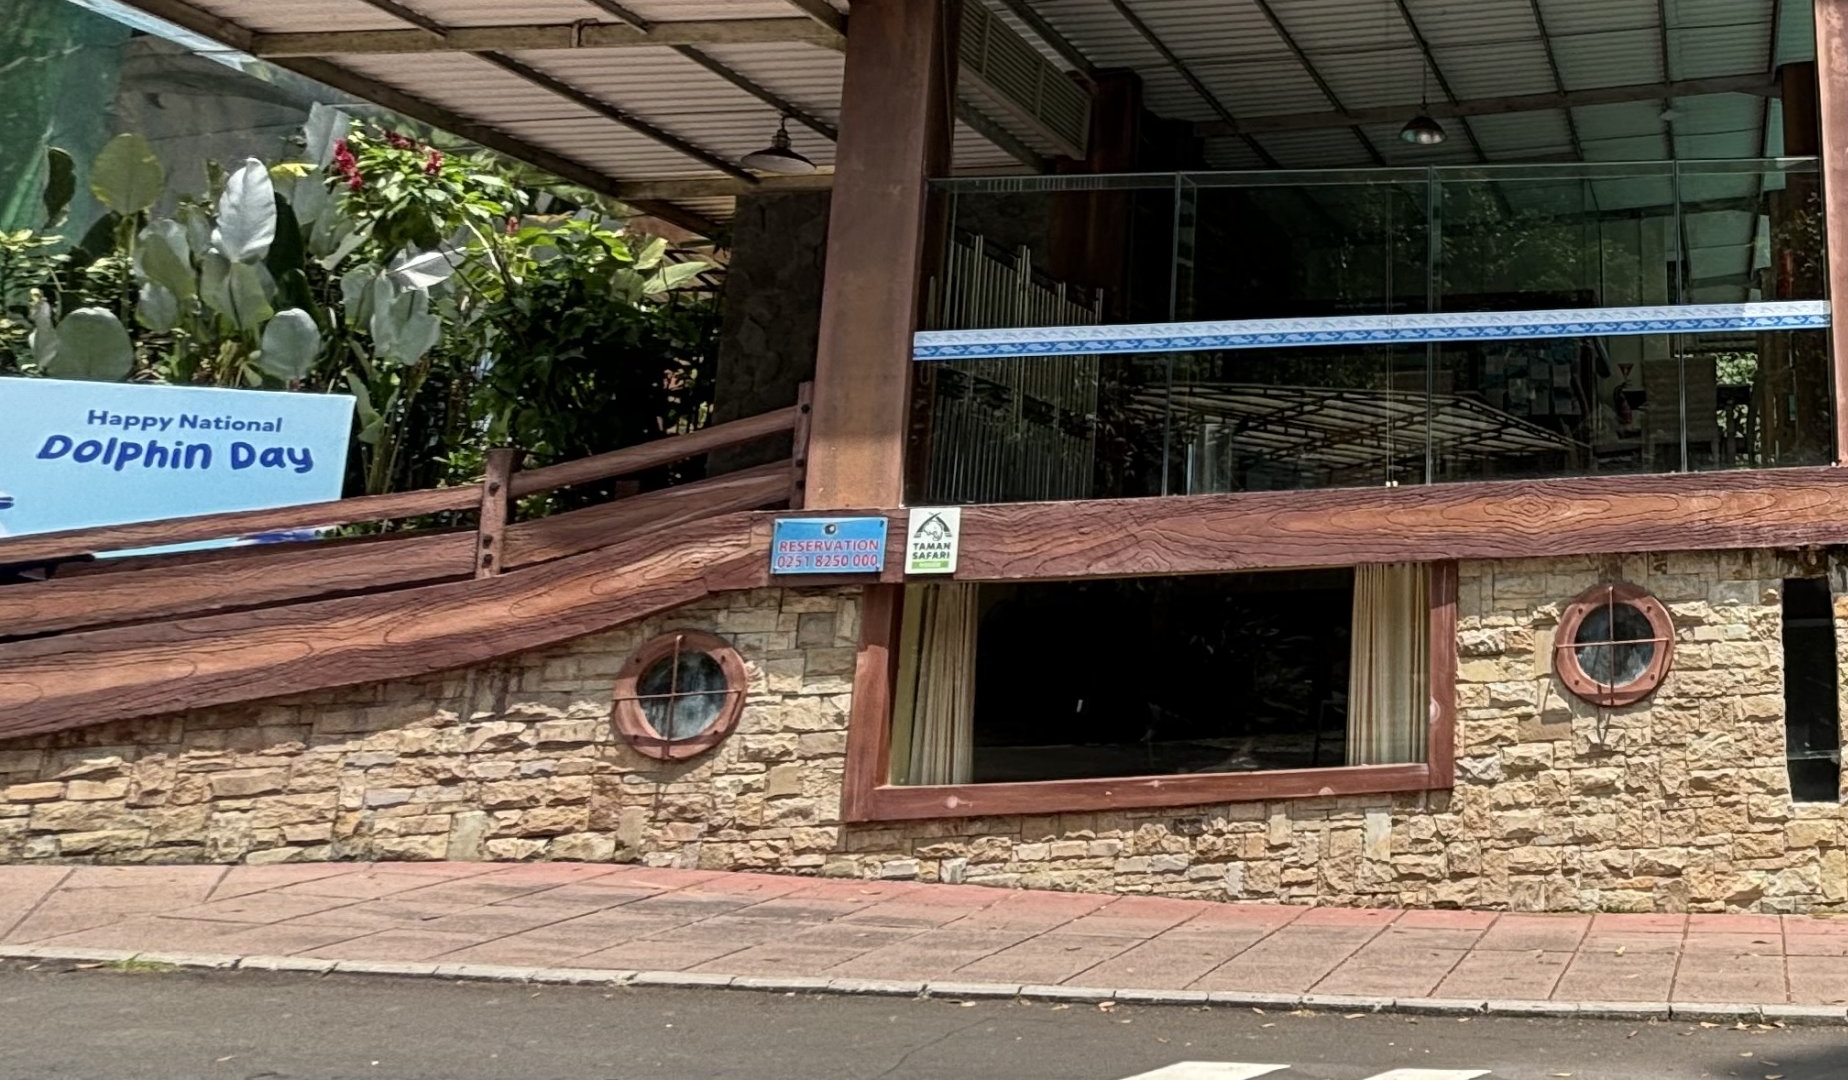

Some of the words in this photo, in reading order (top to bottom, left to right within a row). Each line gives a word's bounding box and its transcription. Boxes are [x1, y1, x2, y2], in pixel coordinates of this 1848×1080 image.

[87, 409, 174, 432] Happy
[179, 413, 283, 433] National
[36, 434, 213, 472] Dolphin
[230, 441, 314, 474] Day
[779, 539, 880, 553] RESERVATION
[913, 542, 952, 551] TAMAN
[777, 555, 810, 569] 0251
[815, 554, 849, 568] 8250
[853, 553, 878, 567] 000
[912, 551, 950, 560] SAFARI
